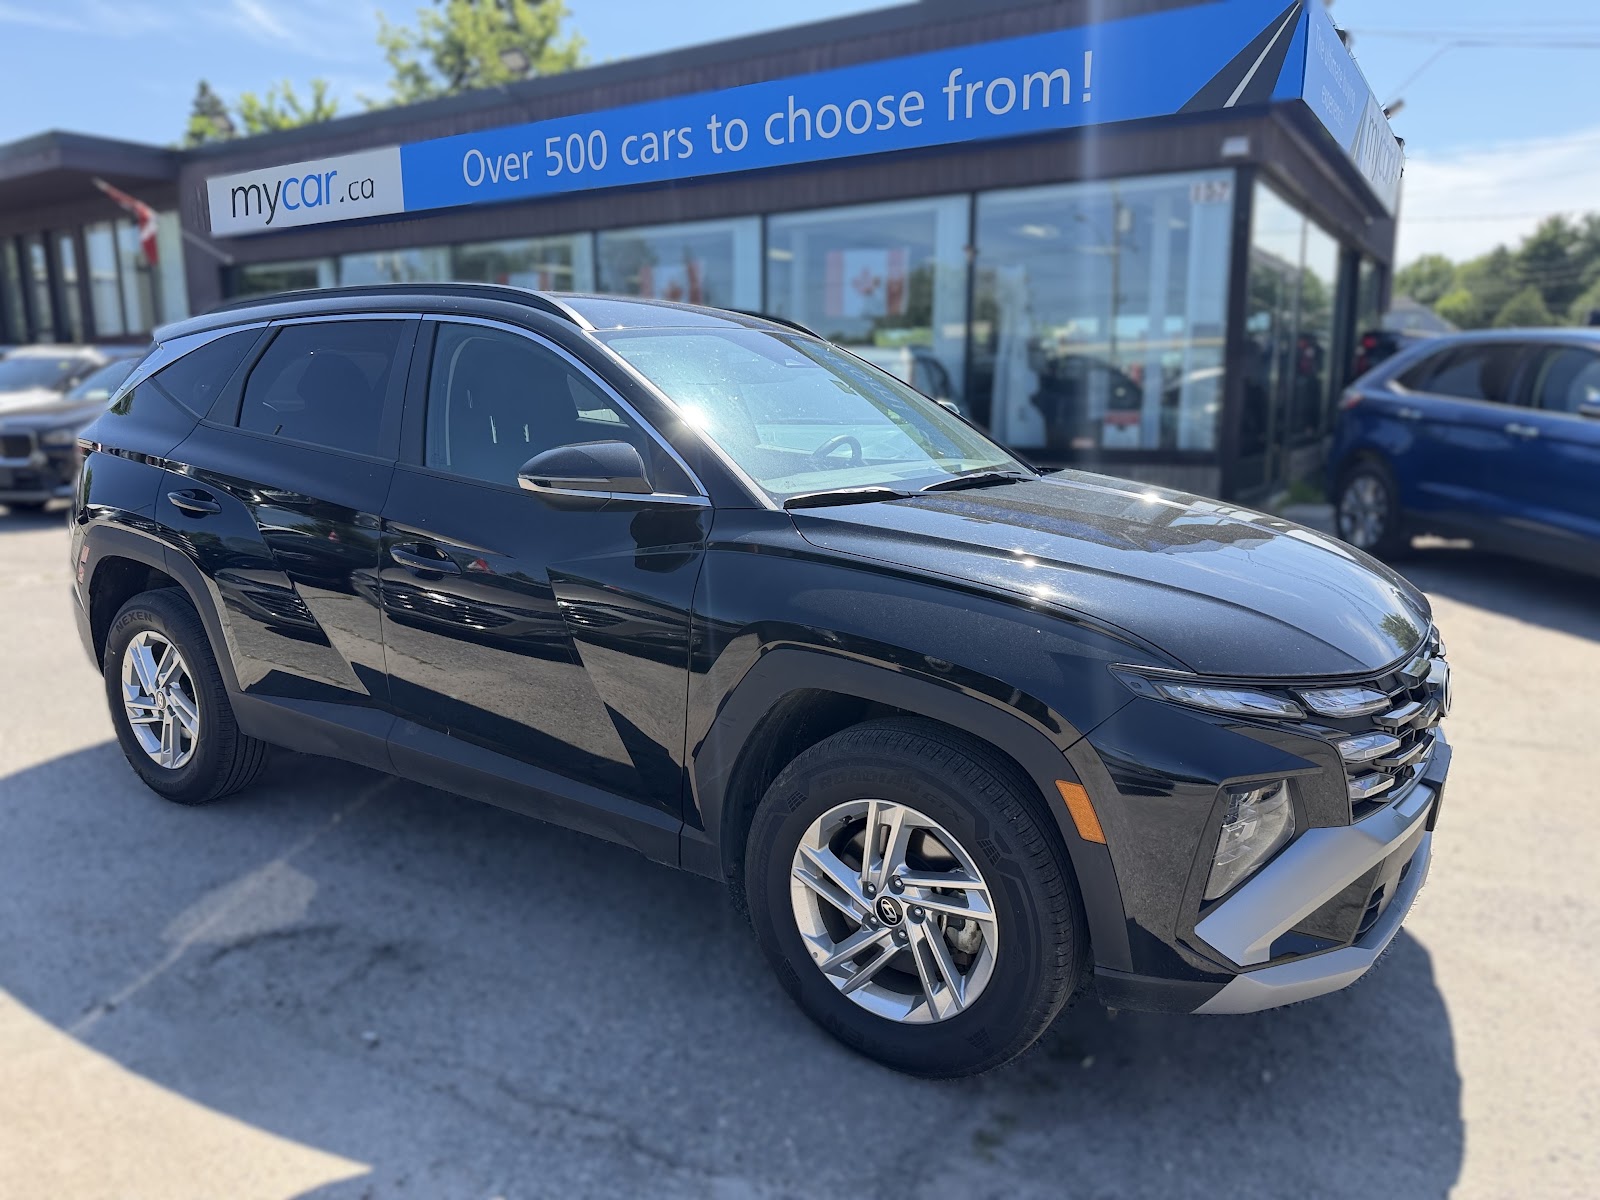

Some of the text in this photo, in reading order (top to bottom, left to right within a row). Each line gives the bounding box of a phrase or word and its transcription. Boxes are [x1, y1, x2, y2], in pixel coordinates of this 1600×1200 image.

[463, 50, 1093, 187] Over 500 cars to choose from!
[232, 169, 375, 226] mycar.ca
[115, 611, 153, 634] NEXEN
